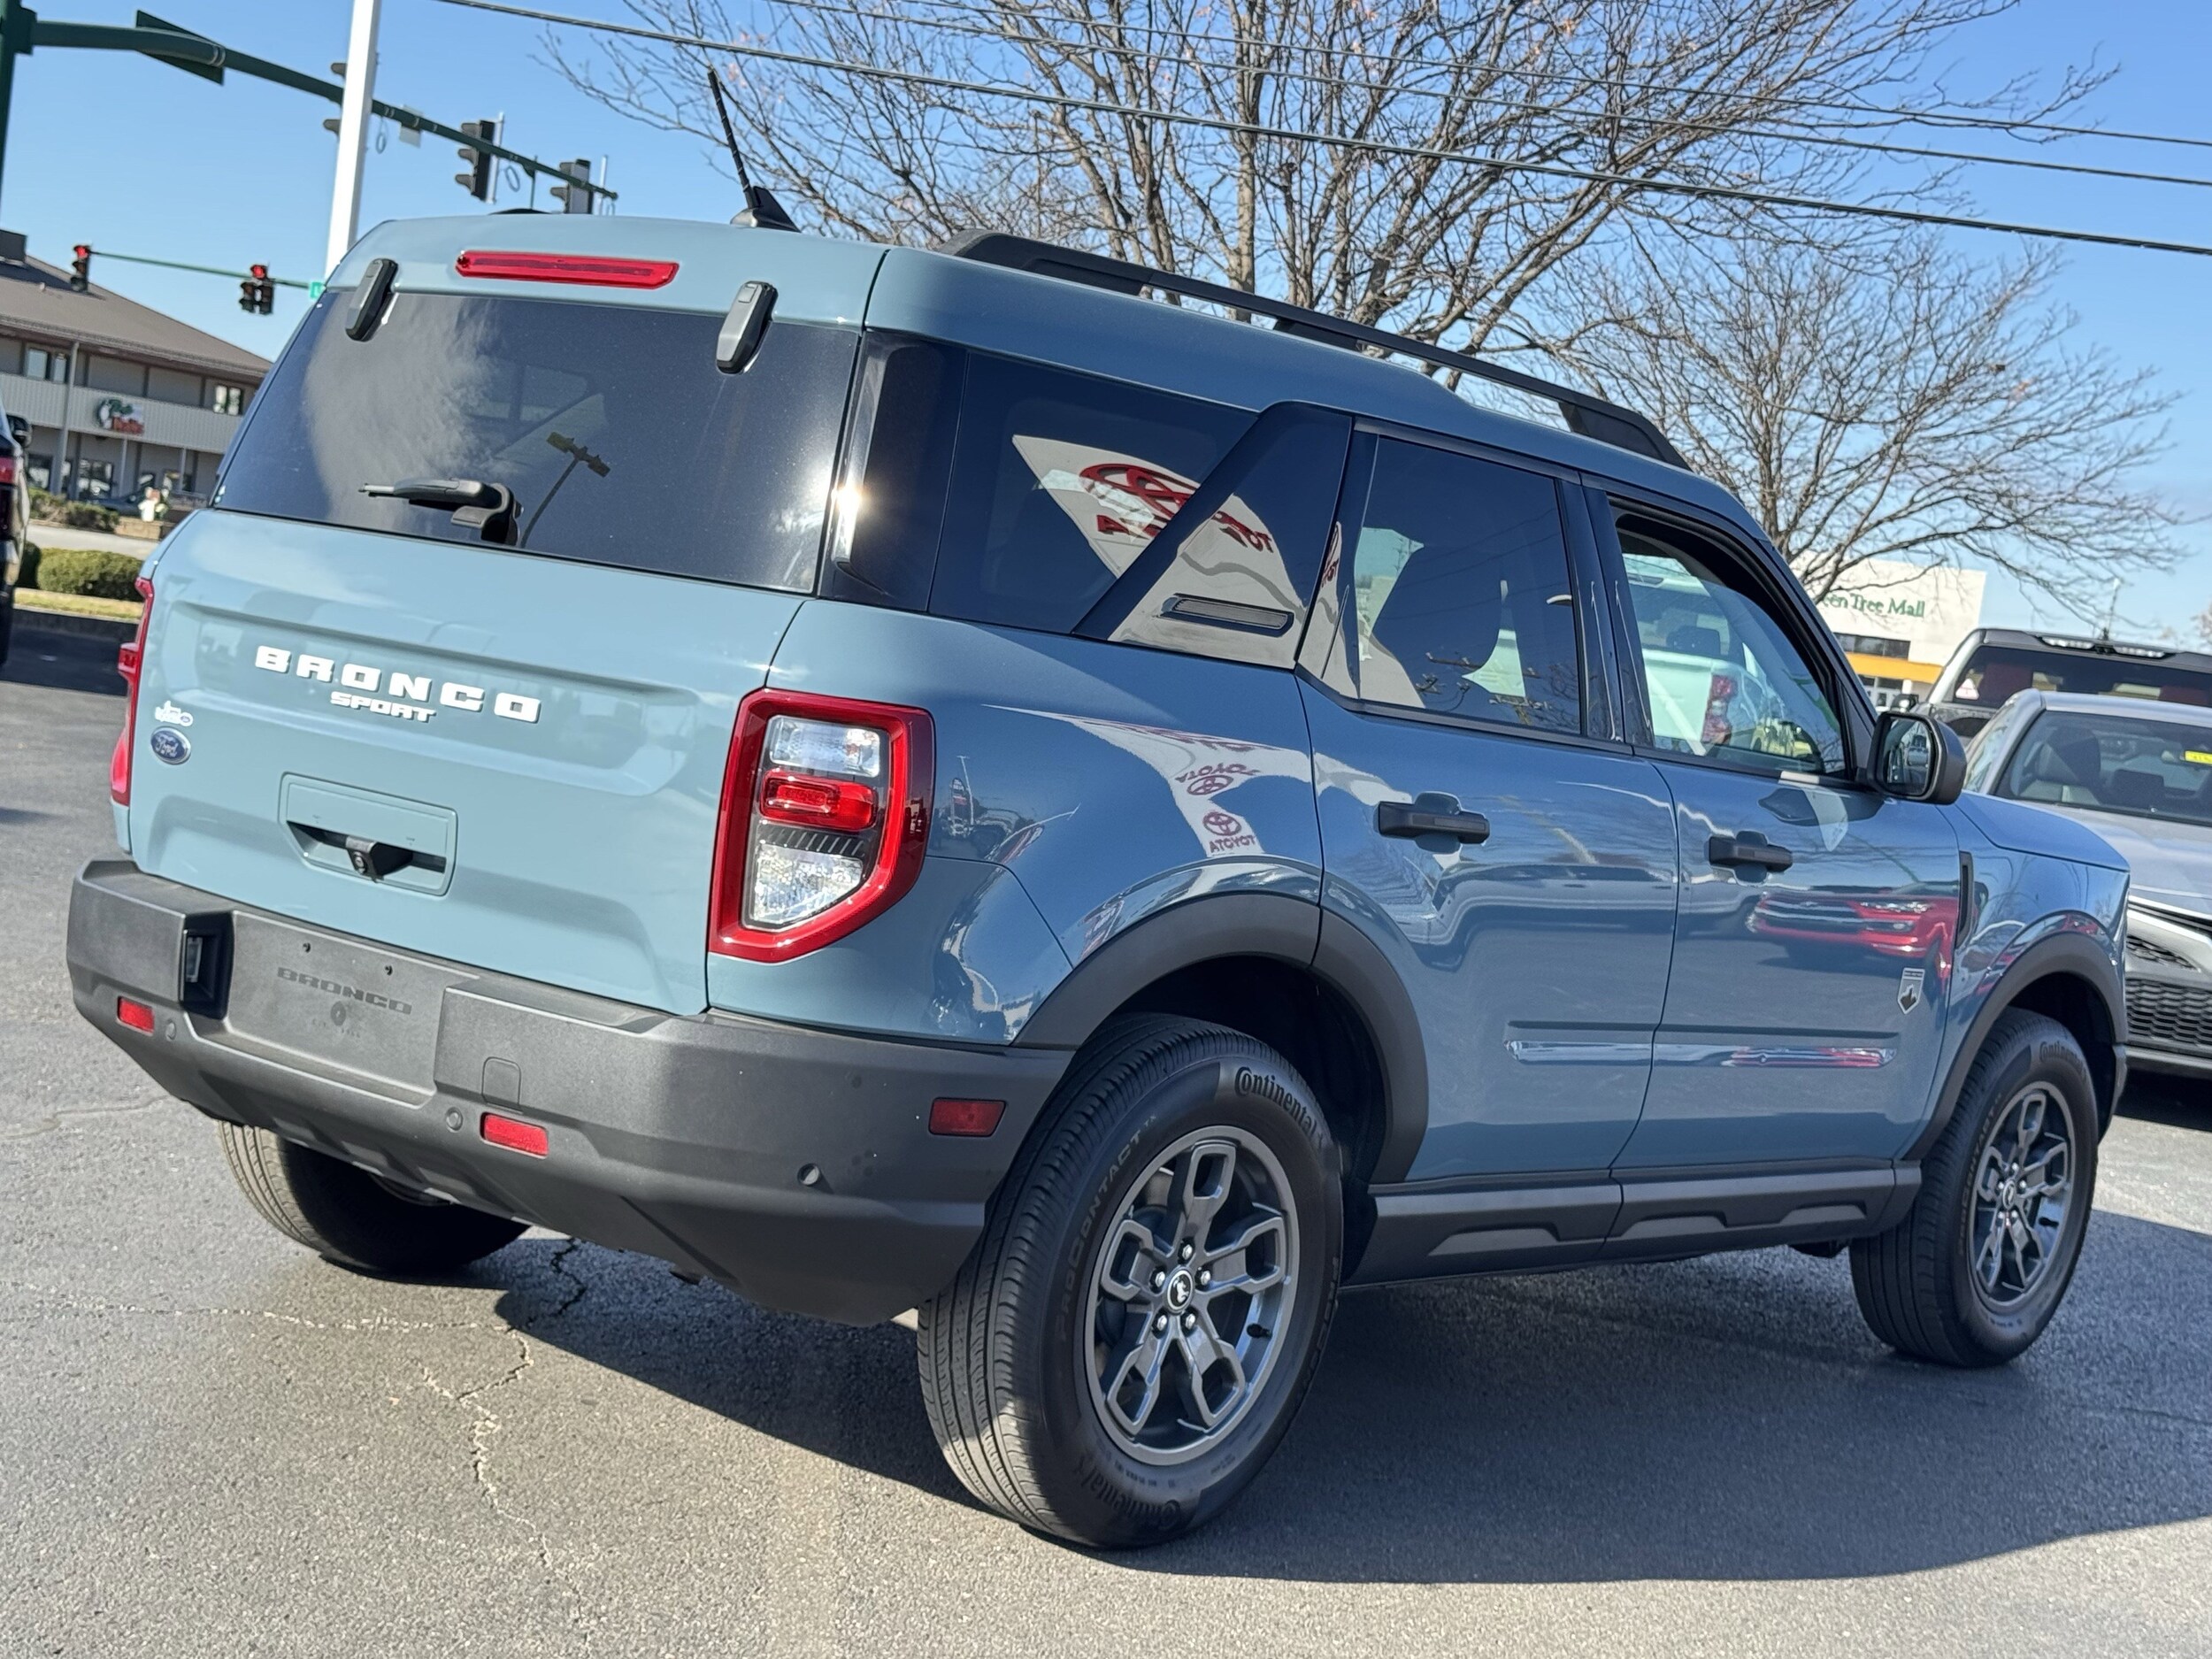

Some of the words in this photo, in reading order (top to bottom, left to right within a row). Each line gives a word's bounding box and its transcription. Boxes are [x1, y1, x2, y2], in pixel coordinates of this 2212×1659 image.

[1850, 592, 1885, 614] Tree
[1887, 598, 1925, 618] Mall
[255, 645, 541, 724] BRONCO
[330, 691, 437, 723] SPORT
[277, 966, 412, 1015] BRONCO
[1234, 1066, 1317, 1137] Continental
